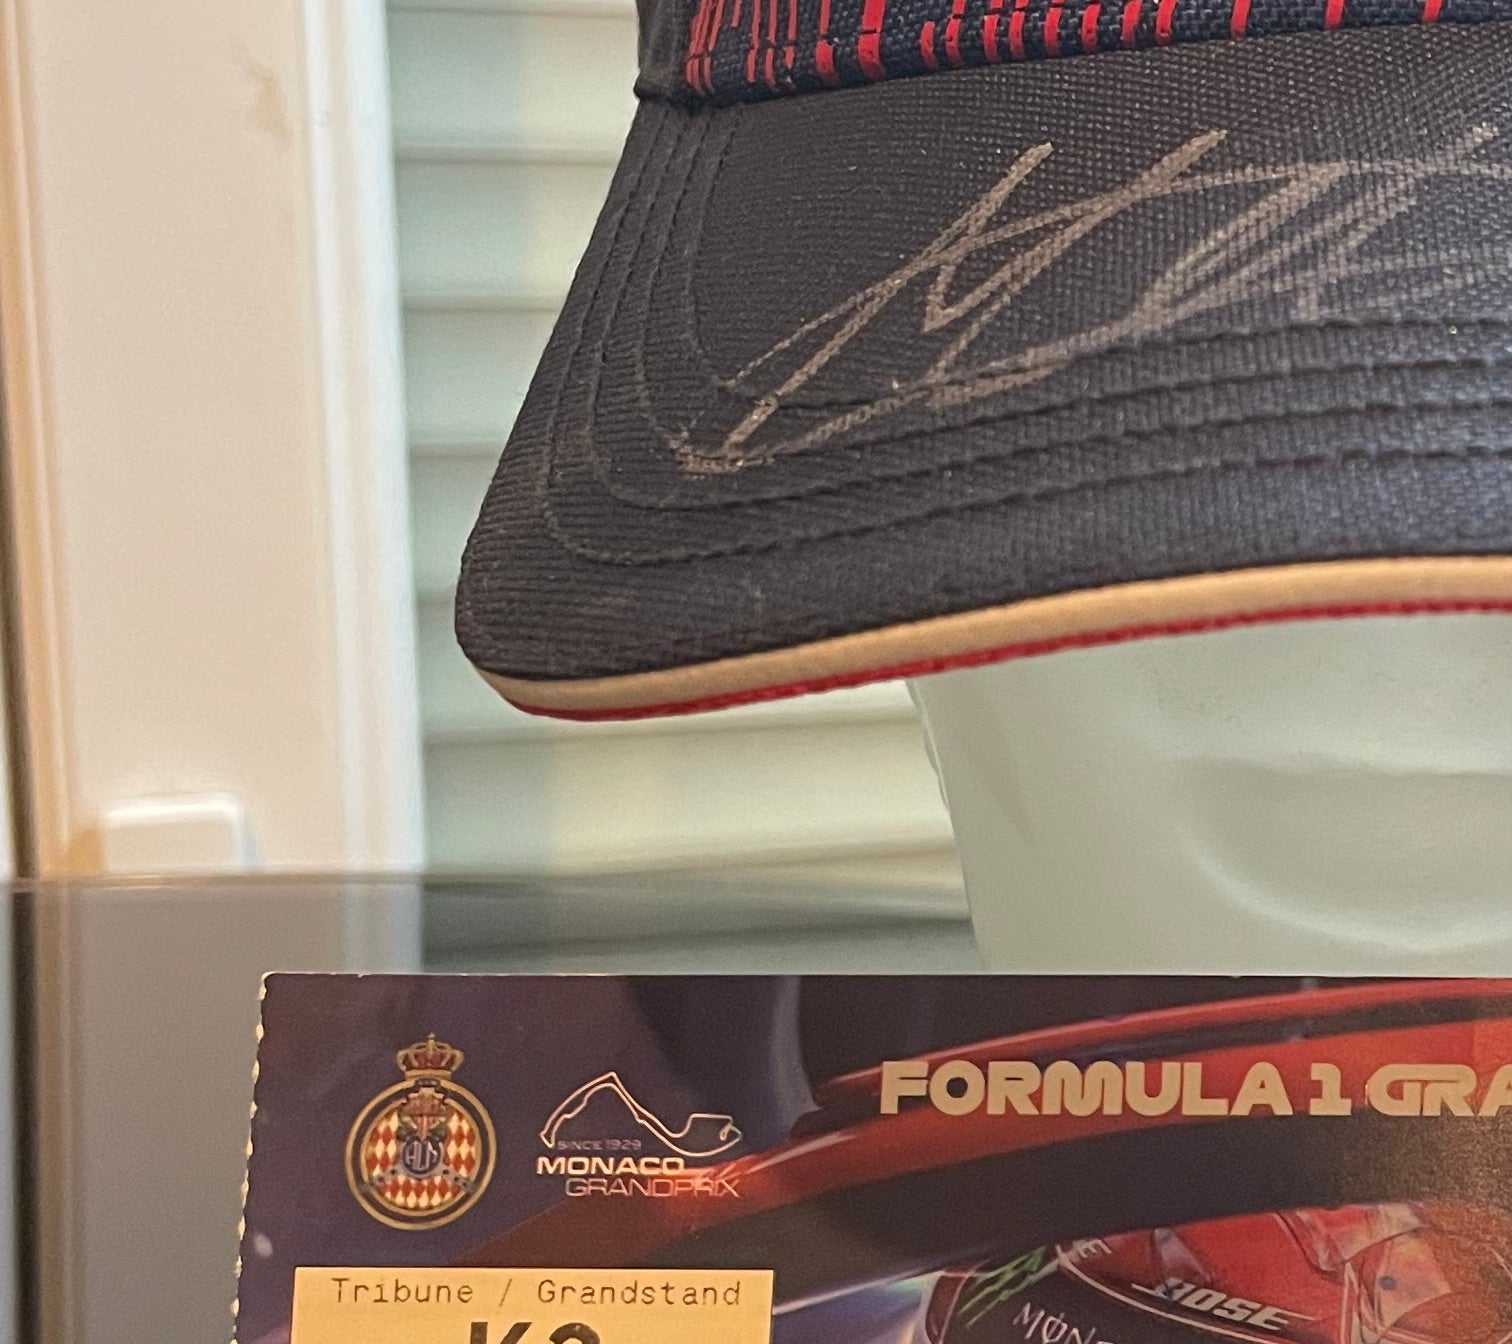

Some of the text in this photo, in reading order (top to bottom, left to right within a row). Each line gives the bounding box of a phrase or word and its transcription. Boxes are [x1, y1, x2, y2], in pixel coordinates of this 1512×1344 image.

[880, 1060, 1292, 1117] FORMULA
[1309, 1063, 1353, 1117] 1
[557, 1139, 602, 1151] SINCE
[537, 1156, 685, 1175] MONACO
[331, 1277, 474, 1304] Tribune
[537, 1279, 740, 1306] Grandstand
